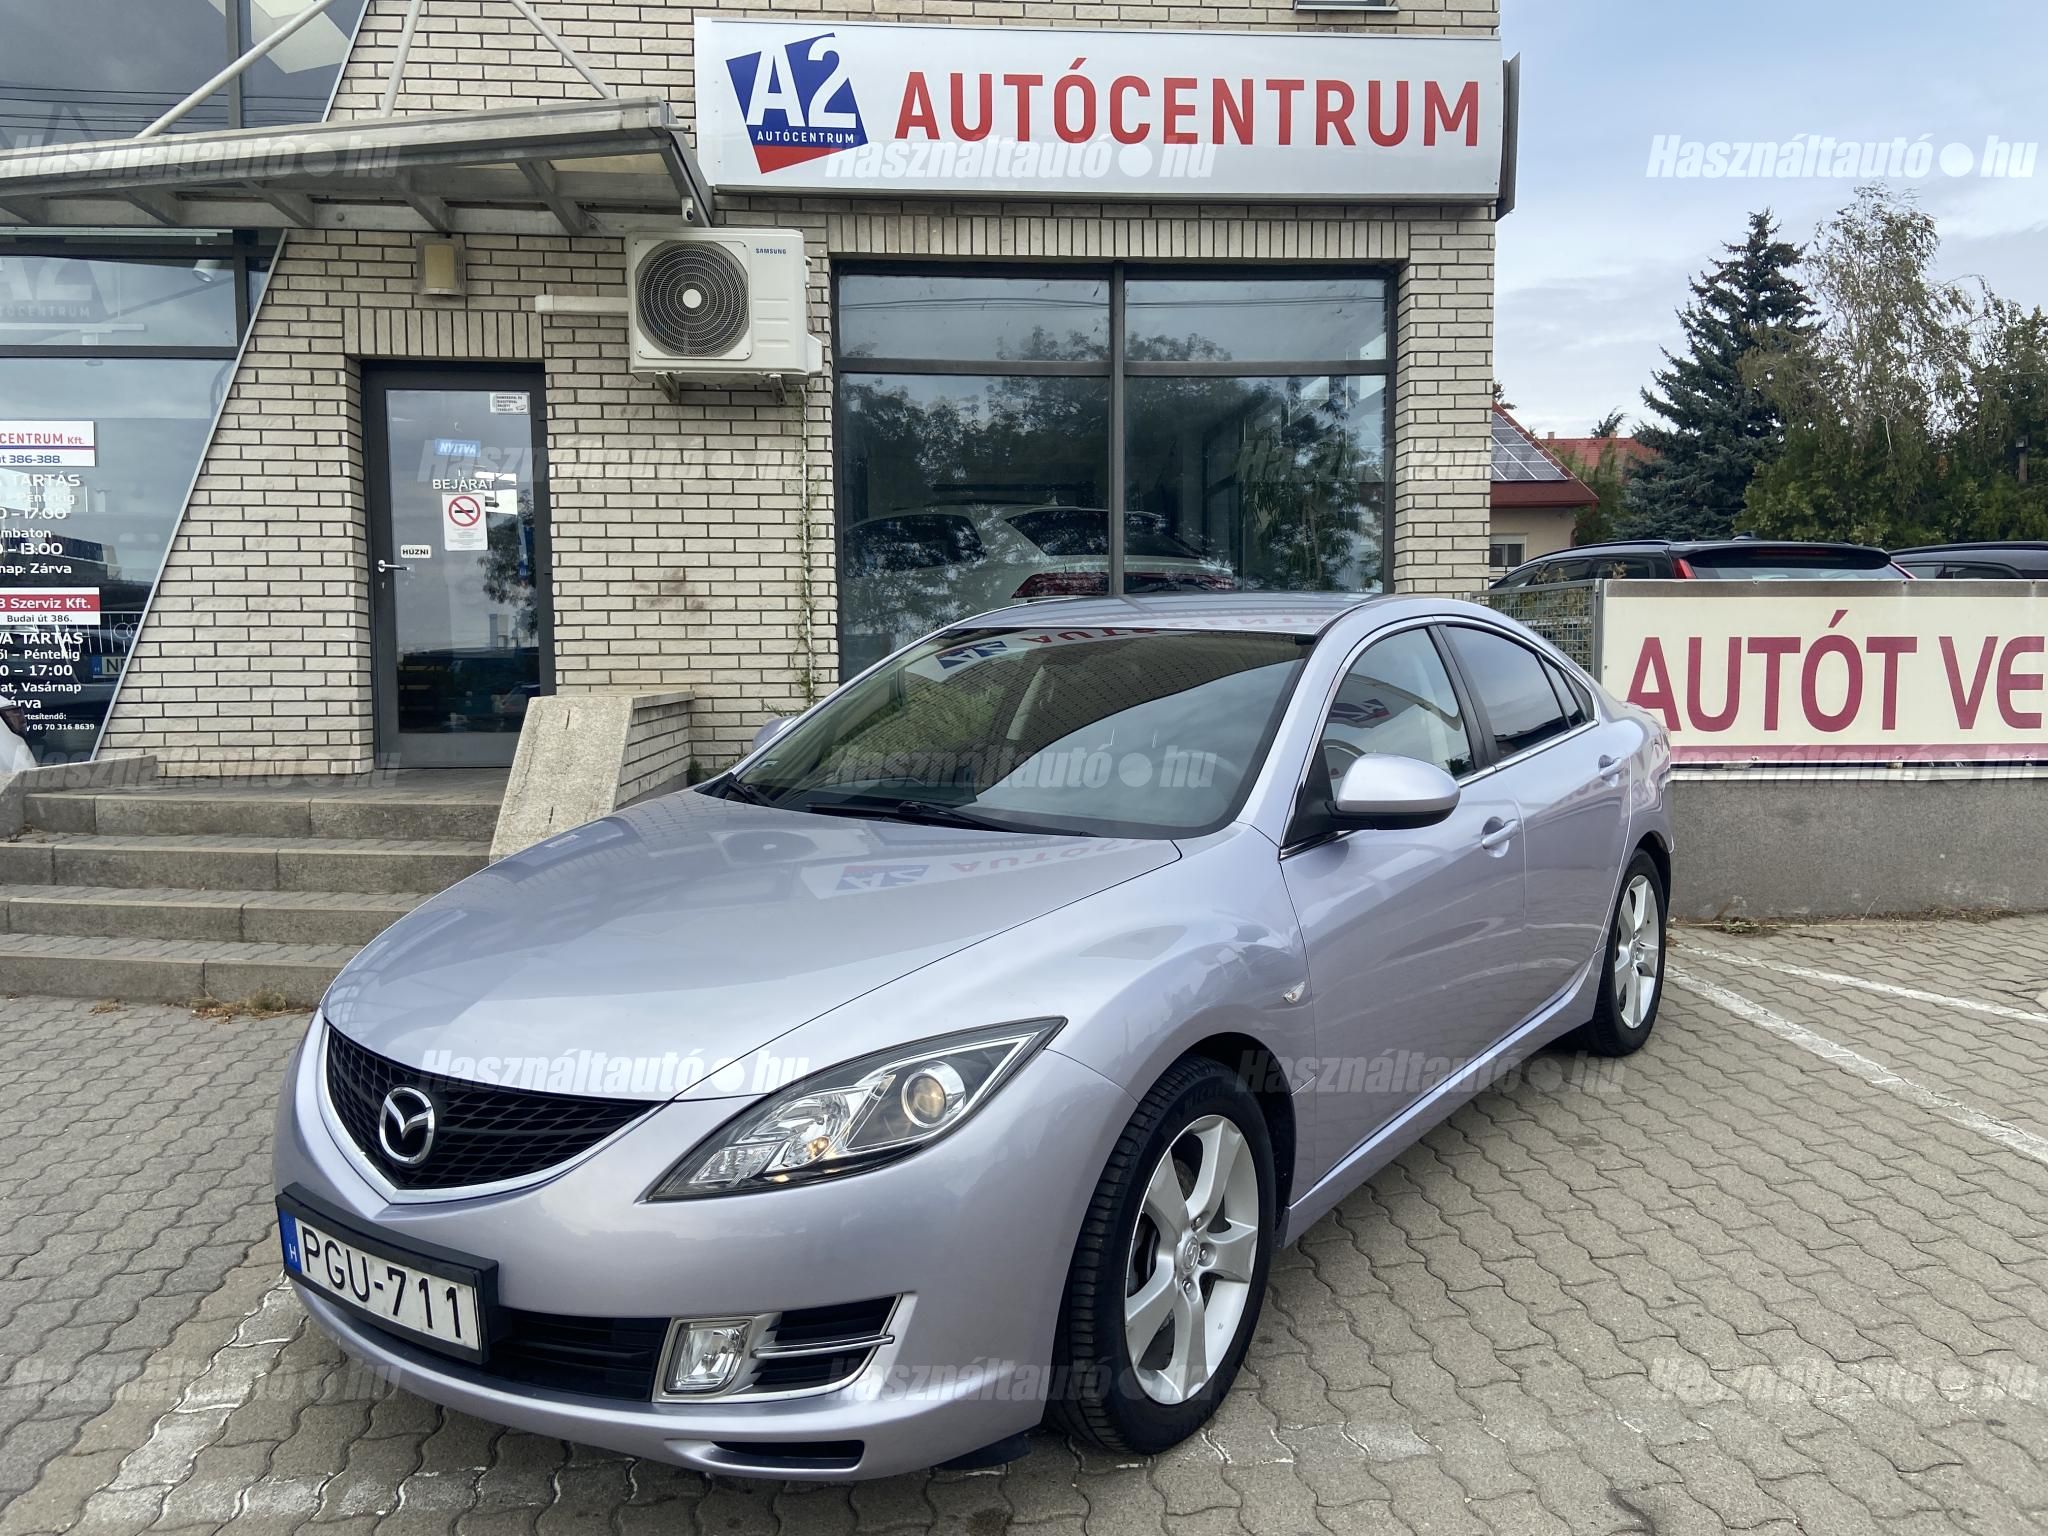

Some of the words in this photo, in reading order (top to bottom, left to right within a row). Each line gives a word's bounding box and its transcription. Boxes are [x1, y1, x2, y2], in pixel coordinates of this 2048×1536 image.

[745, 36, 857, 128] A2
[895, 58, 1479, 147] AUTÓCENTRUM
[757, 129, 855, 144] AUTÓCENTRUM
[755, 247, 787, 255] SAMSUNG
[0, 432, 63, 445] CENTRUM
[439, 442, 477, 455] NYITVA
[432, 476, 494, 490] BEJÁRAT
[24, 507, 67, 519] 17:00
[20, 542, 63, 555] 13:00
[402, 547, 429, 556] HÚZNI
[30, 562, 72, 574] Zárva
[10, 598, 62, 609] Szerviz
[66, 598, 91, 609] Kft.
[7, 614, 35, 623] Budai
[38, 614, 49, 623] út
[51, 614, 73, 623] 386.
[23, 628, 84, 645] TARTÁS
[24, 649, 80, 662] Péntekig
[29, 664, 73, 676] 17:00
[1627, 609, 1918, 733] AUTÓT
[21, 681, 82, 695] Vasárnap
[32, 723, 43, 731] 06
[46, 723, 55, 731] 70
[57, 723, 73, 731] 316
[74, 723, 95, 731] 8639
[288, 1243, 298, 1263] H
[301, 1225, 462, 1339] PGU-711
